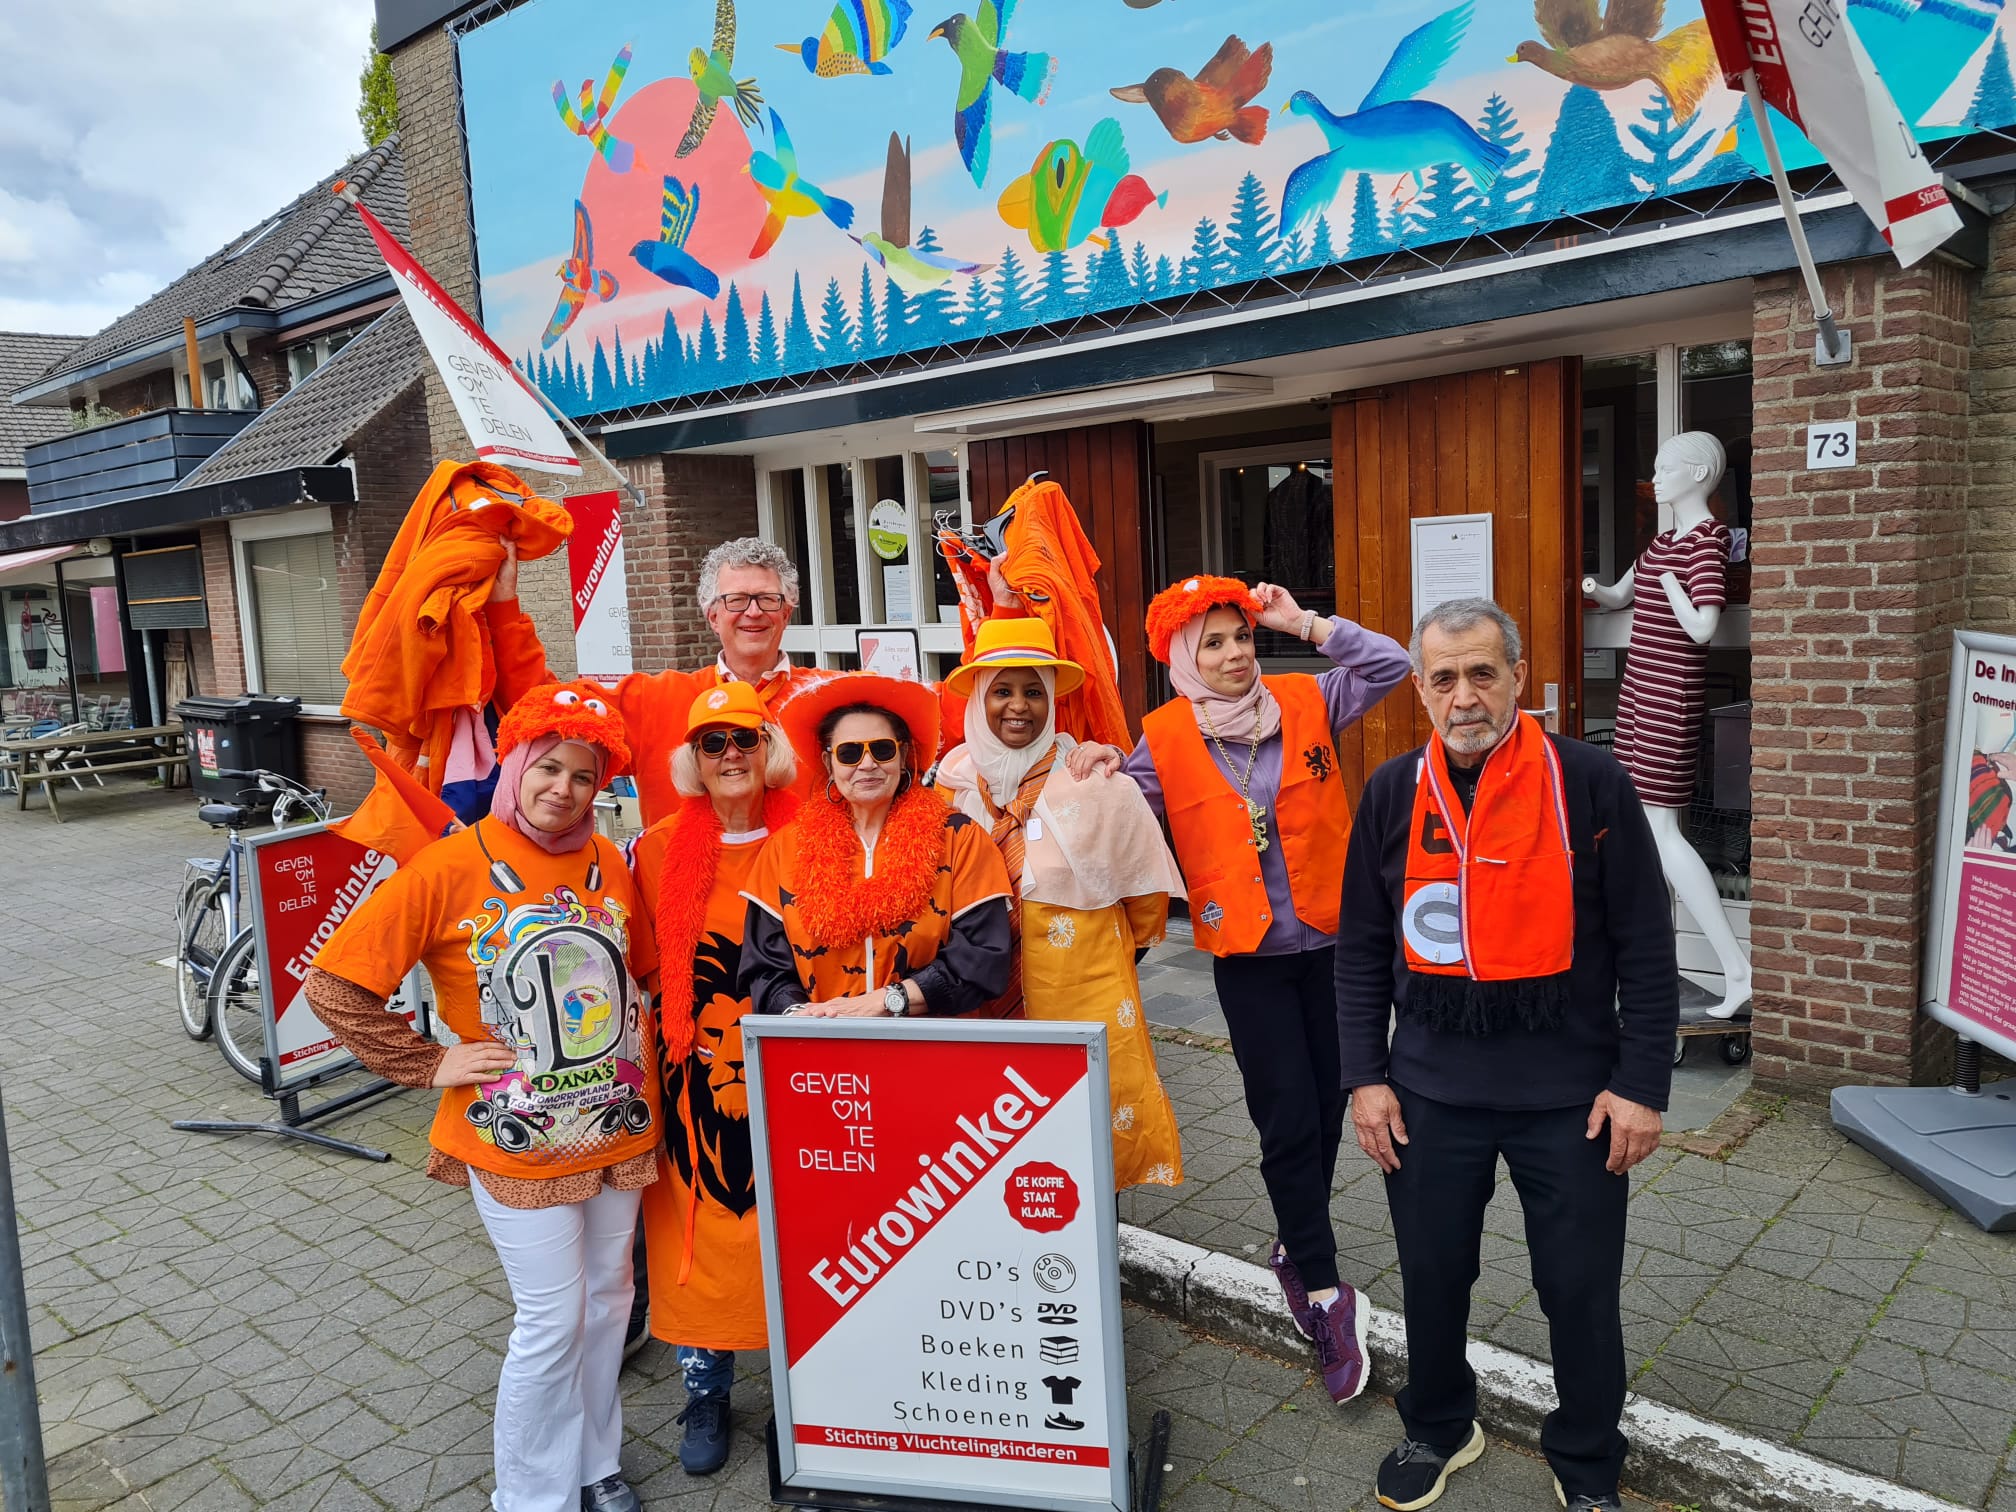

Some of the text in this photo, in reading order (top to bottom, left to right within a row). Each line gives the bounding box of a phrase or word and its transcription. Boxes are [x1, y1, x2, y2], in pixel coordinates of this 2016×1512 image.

[448, 354, 503, 381] GEVEN
[468, 396, 495, 415] TE
[480, 417, 533, 442] DELEN
[1813, 432, 1850, 459] 73
[575, 508, 622, 611] Eurowinkel
[608, 607, 629, 618] GEVE
[611, 645, 631, 656] DELE
[1975, 659, 2016, 684] De In
[274, 855, 313, 873] GEVEN
[302, 881, 317, 894] TE
[278, 894, 318, 913] DELEN
[284, 849, 381, 982] Eurowinke
[293, 1041, 330, 1059] Stichting
[533, 1082, 611, 1104] TOMORROWLAND
[789, 1072, 870, 1095] GEVEN
[540, 1100, 575, 1111] YOUTH
[578, 1093, 609, 1107] QUEEN
[612, 1086, 628, 1098] 2014
[844, 1125, 875, 1148] TE
[799, 1148, 875, 1173] DELEN
[808, 1065, 1052, 1307] Eurowinkel
[1015, 1176, 1065, 1189] DE KOFFIE
[1023, 1191, 1057, 1203] STAAT
[957, 1257, 1052, 1282] CD's CD
[940, 1299, 1078, 1323] DVD's DVD
[921, 1334, 1024, 1359] Boeken
[921, 1370, 1028, 1400] Kleding
[893, 1401, 1029, 1428] Schoenen
[825, 1427, 1077, 1462] Stichting Vluchtelingkinderen
